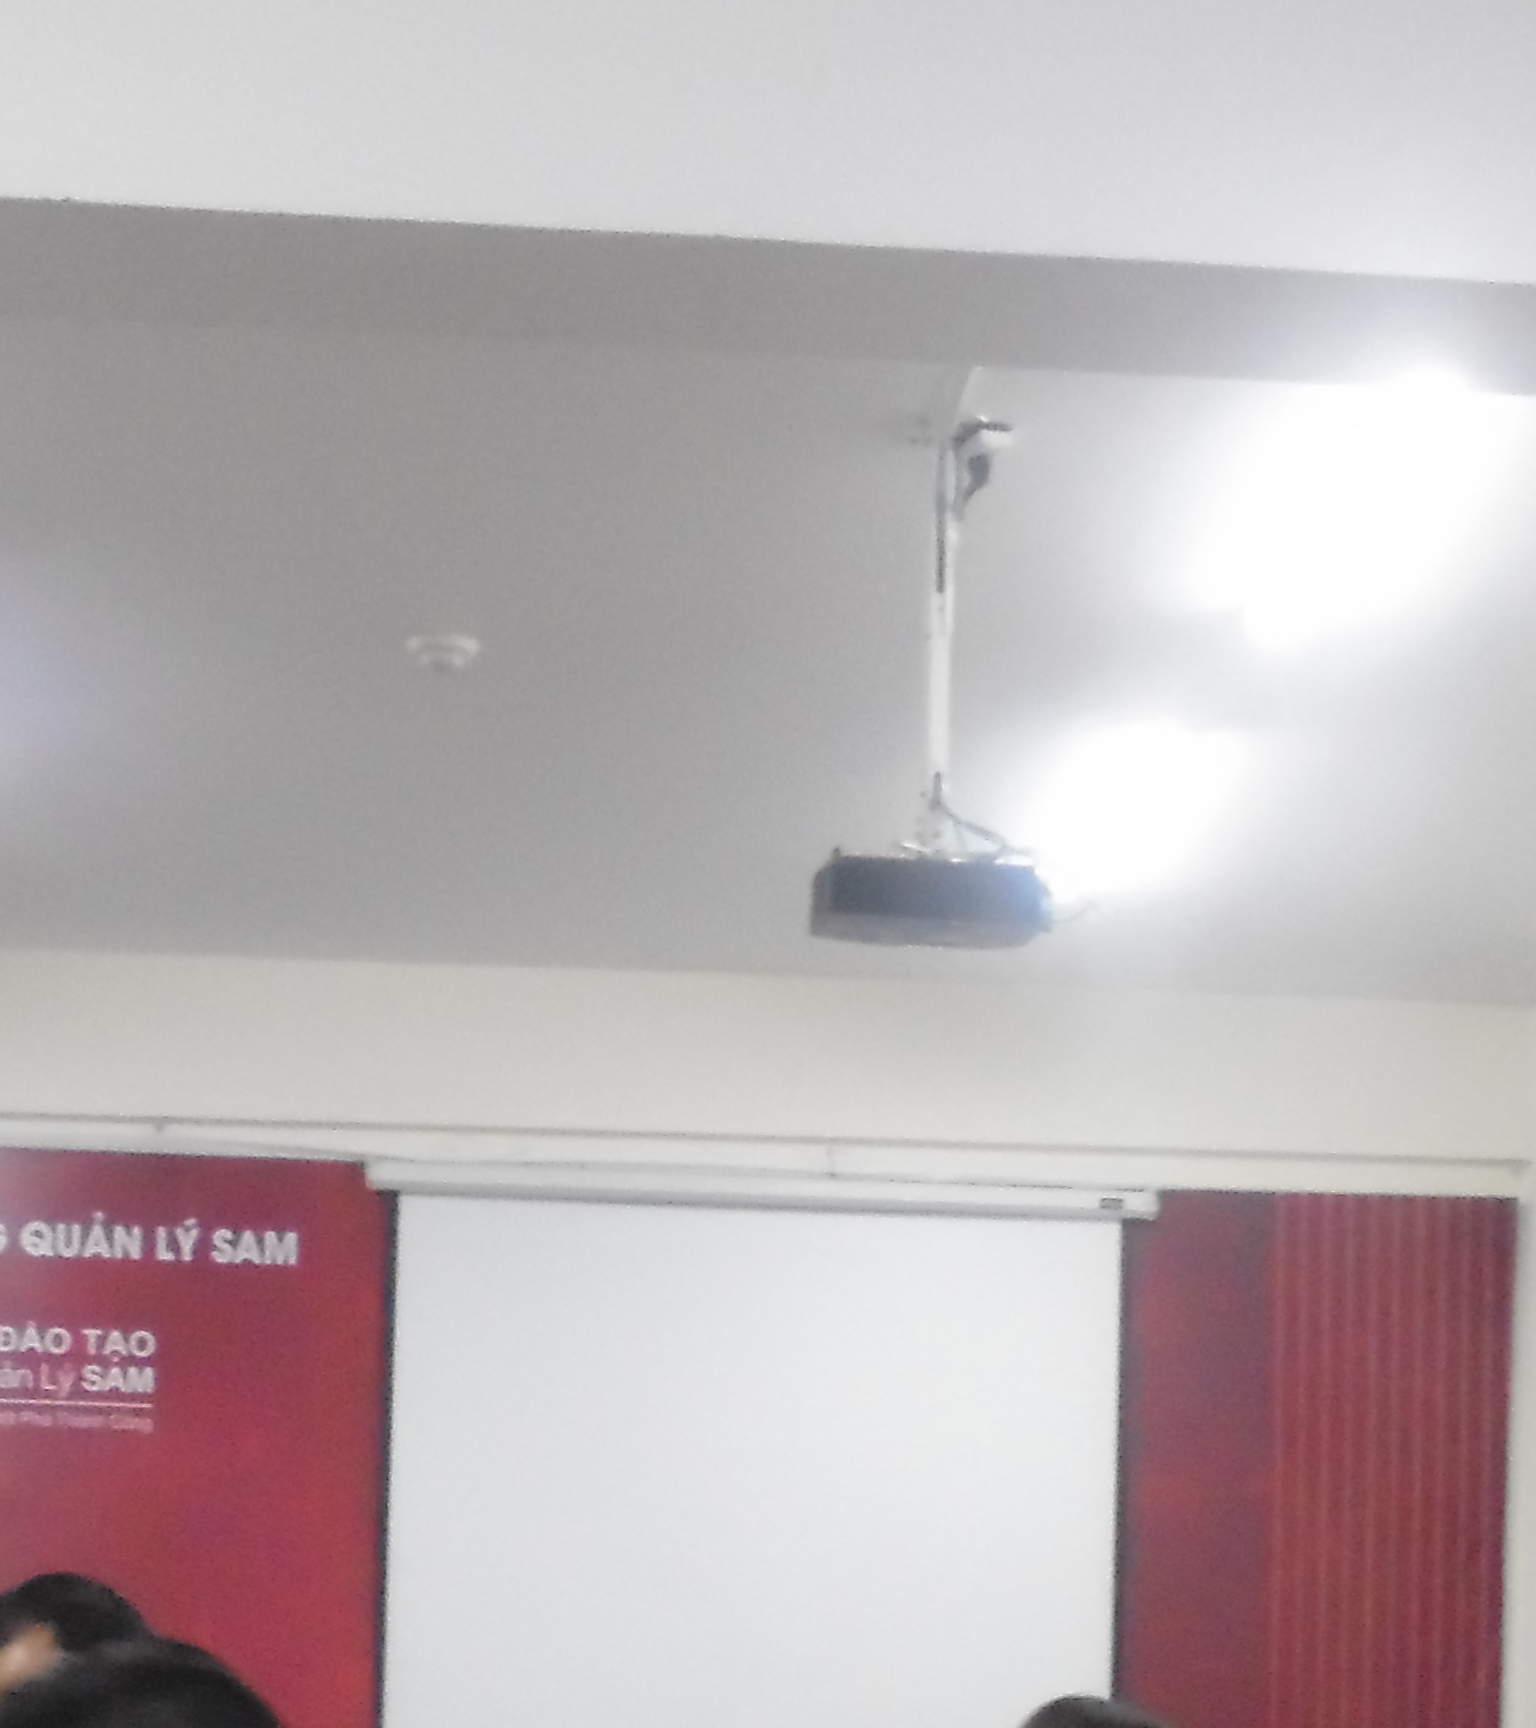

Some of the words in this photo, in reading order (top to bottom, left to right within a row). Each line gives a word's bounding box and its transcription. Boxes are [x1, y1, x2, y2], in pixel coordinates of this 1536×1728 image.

[19, 1210, 144, 1260] QUẢN
[155, 1218, 199, 1262] LÝ
[210, 1228, 300, 1266] SAM
[80, 1364, 157, 1394] SAM
